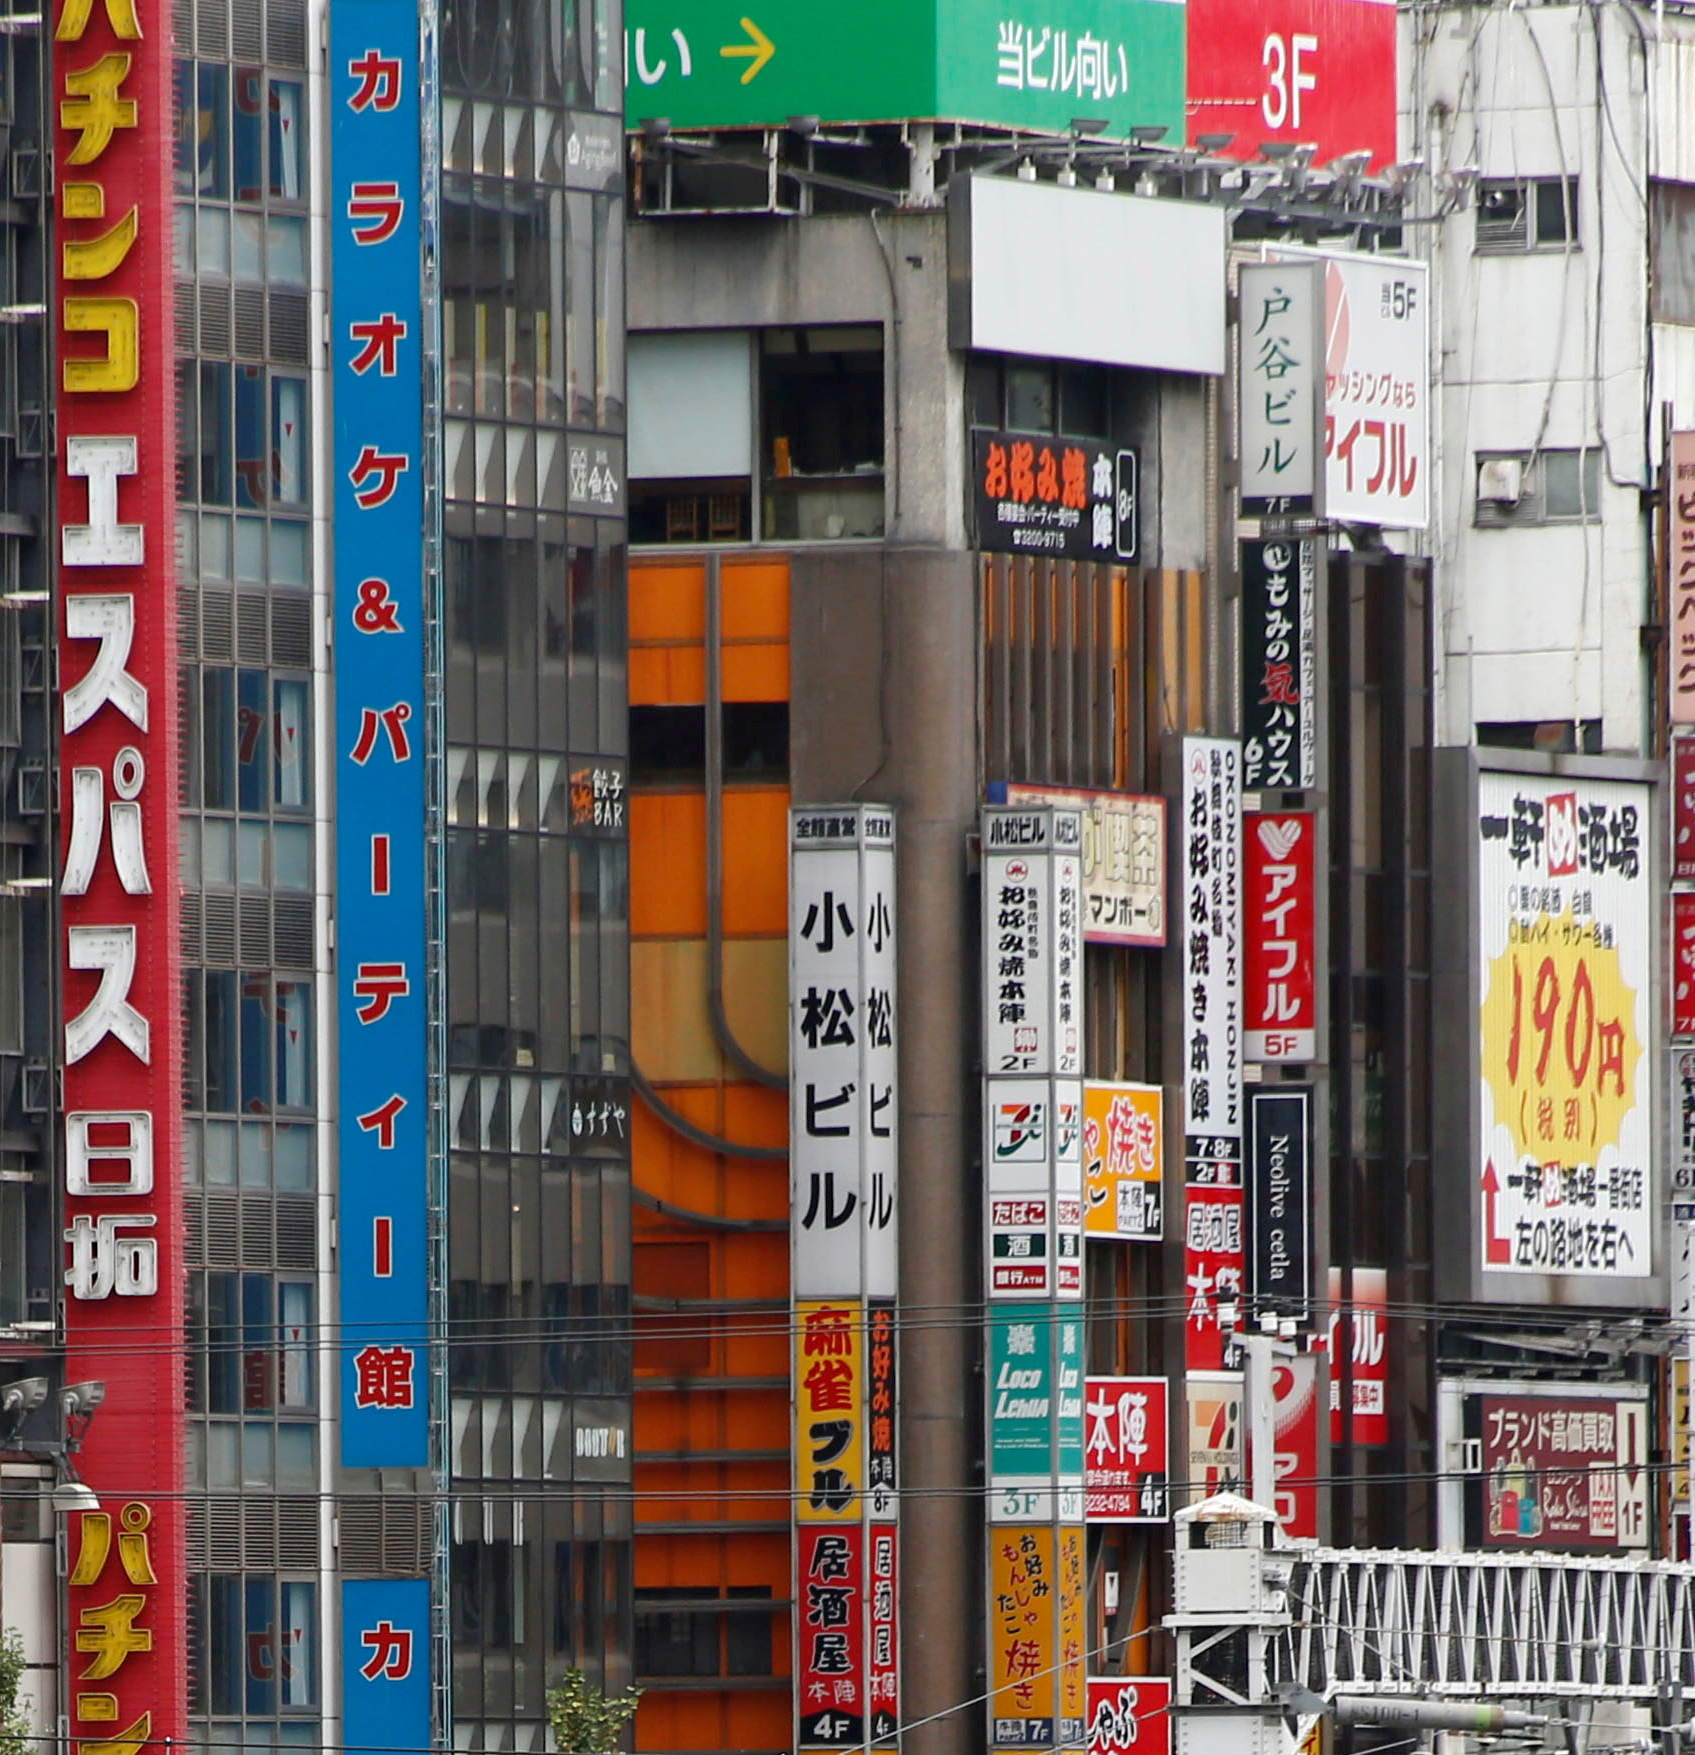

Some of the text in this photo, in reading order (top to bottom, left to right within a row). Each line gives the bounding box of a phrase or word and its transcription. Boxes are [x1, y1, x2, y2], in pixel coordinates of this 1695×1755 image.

[996, 21, 1129, 98] 当ビル向い
[1262, 33, 1317, 129] 3F
[1393, 281, 1417, 320] 5F
[1253, 286, 1301, 475] 戸谷ビル
[1258, 572, 1300, 787] もみの気ハウス
[593, 801, 624, 827] BAR
[990, 817, 1045, 844] 小松ビル
[1480, 790, 1640, 880] 一軒め酒場
[1089, 894, 1147, 925] マンボー
[1225, 749, 1237, 1125] OKONOMIYAKI HONJIN
[1260, 863, 1302, 1023] アイフル
[1263, 1033, 1298, 1057] 5F
[1507, 953, 1626, 1099] 190円
[800, 891, 857, 1233] 小松ビル
[867, 891, 893, 1233] 小松ビル
[1001, 1056, 1037, 1071] 2F
[1269, 1134, 1289, 1218] Neolive
[994, 1202, 1045, 1224] たばこ
[1515, 1214, 1635, 1270] 左の路地を右へ
[1008, 1234, 1032, 1257] 酒
[872, 1310, 893, 1452] お好み焼
[1224, 1346, 1241, 1369] 4F
[1086, 1387, 1148, 1467] 本陣
[1488, 1407, 1615, 1453] ブランド高価買取
[1140, 1474, 1162, 1516] 4F
[1621, 1500, 1643, 1536] 1F
[808, 1536, 854, 1676] 居酒屋
[874, 1536, 893, 1667] 居酒屋
[808, 1680, 855, 1705] 本陣
[1005, 1639, 1042, 1711] 焼き
[812, 1713, 850, 1739] 4F
[1029, 1719, 1048, 1741] 7F
